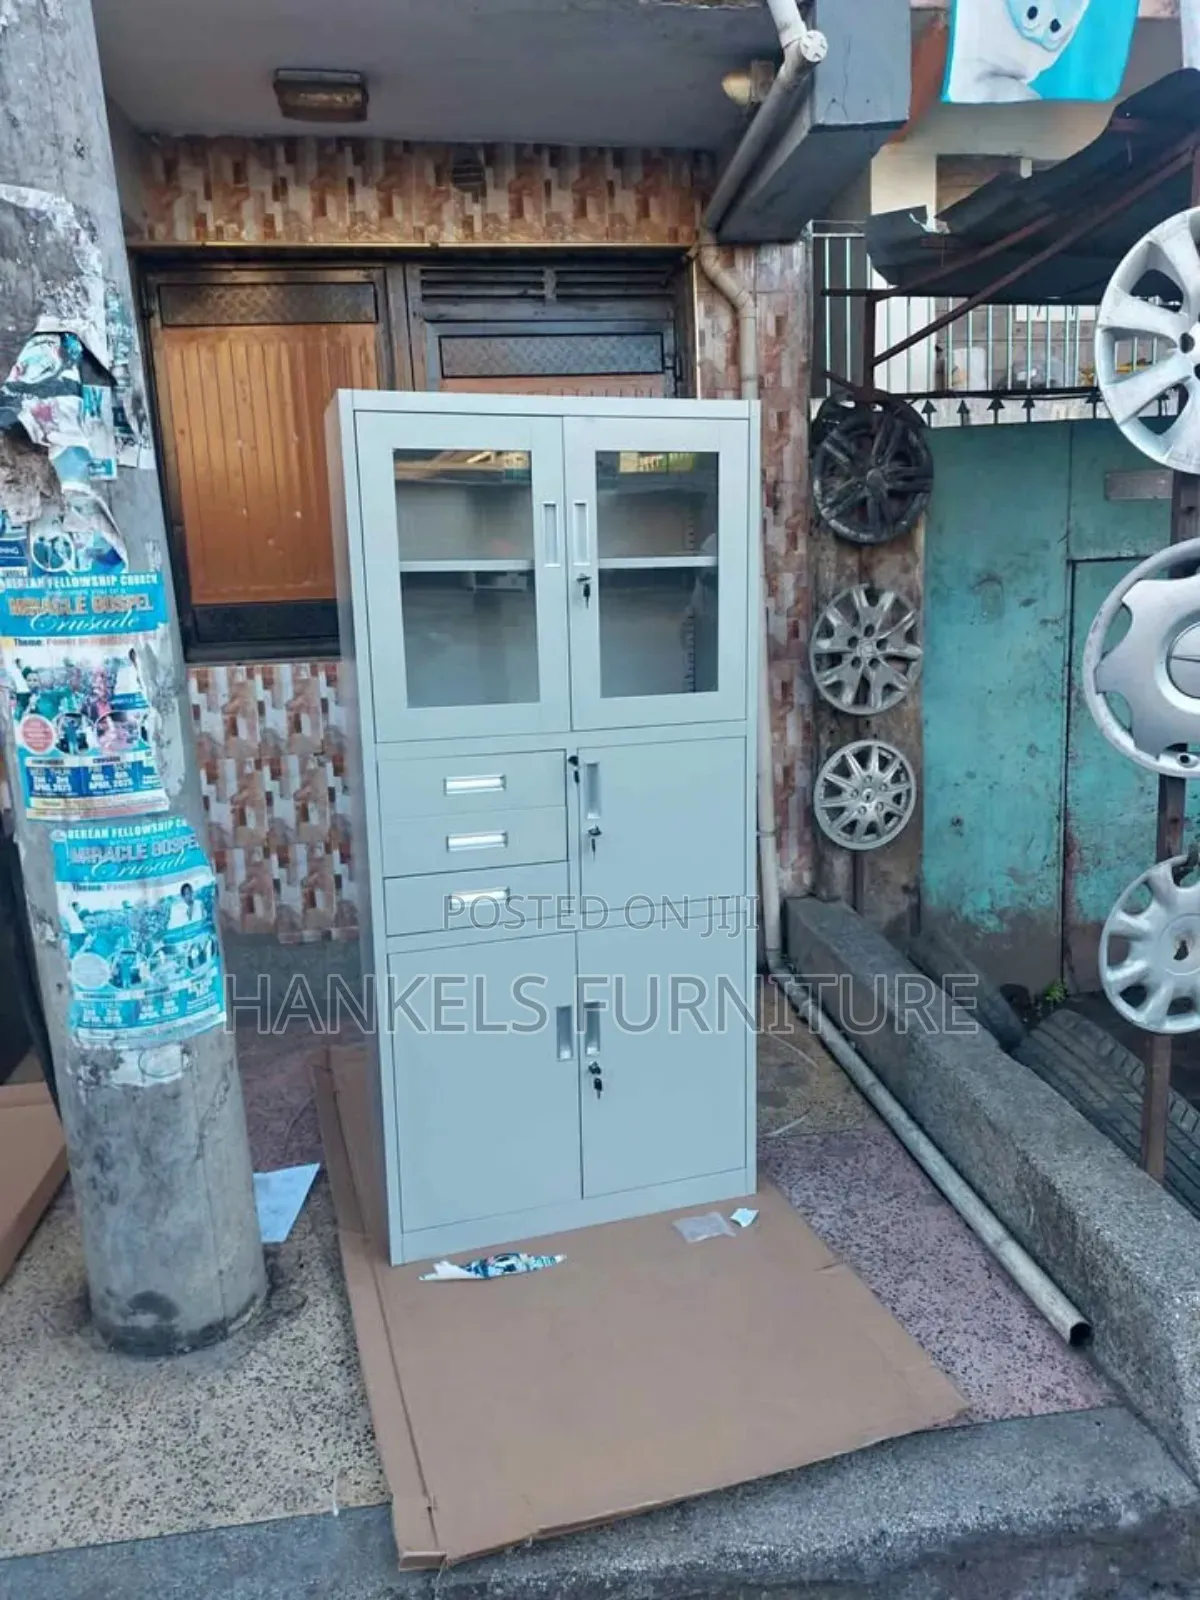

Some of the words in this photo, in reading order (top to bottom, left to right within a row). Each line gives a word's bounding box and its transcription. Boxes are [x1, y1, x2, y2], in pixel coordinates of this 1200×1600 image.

[46, 574, 117, 589] FELLOWSHIP
[119, 573, 158, 586] CHURCH
[9, 594, 88, 616] MIRACLE
[91, 593, 154, 614] GOSPEL
[30, 609, 140, 632] Crusade
[67, 828, 109, 840] BEREAN
[111, 820, 174, 838] FELLOWSHIP
[69, 841, 148, 864] MIRACLE
